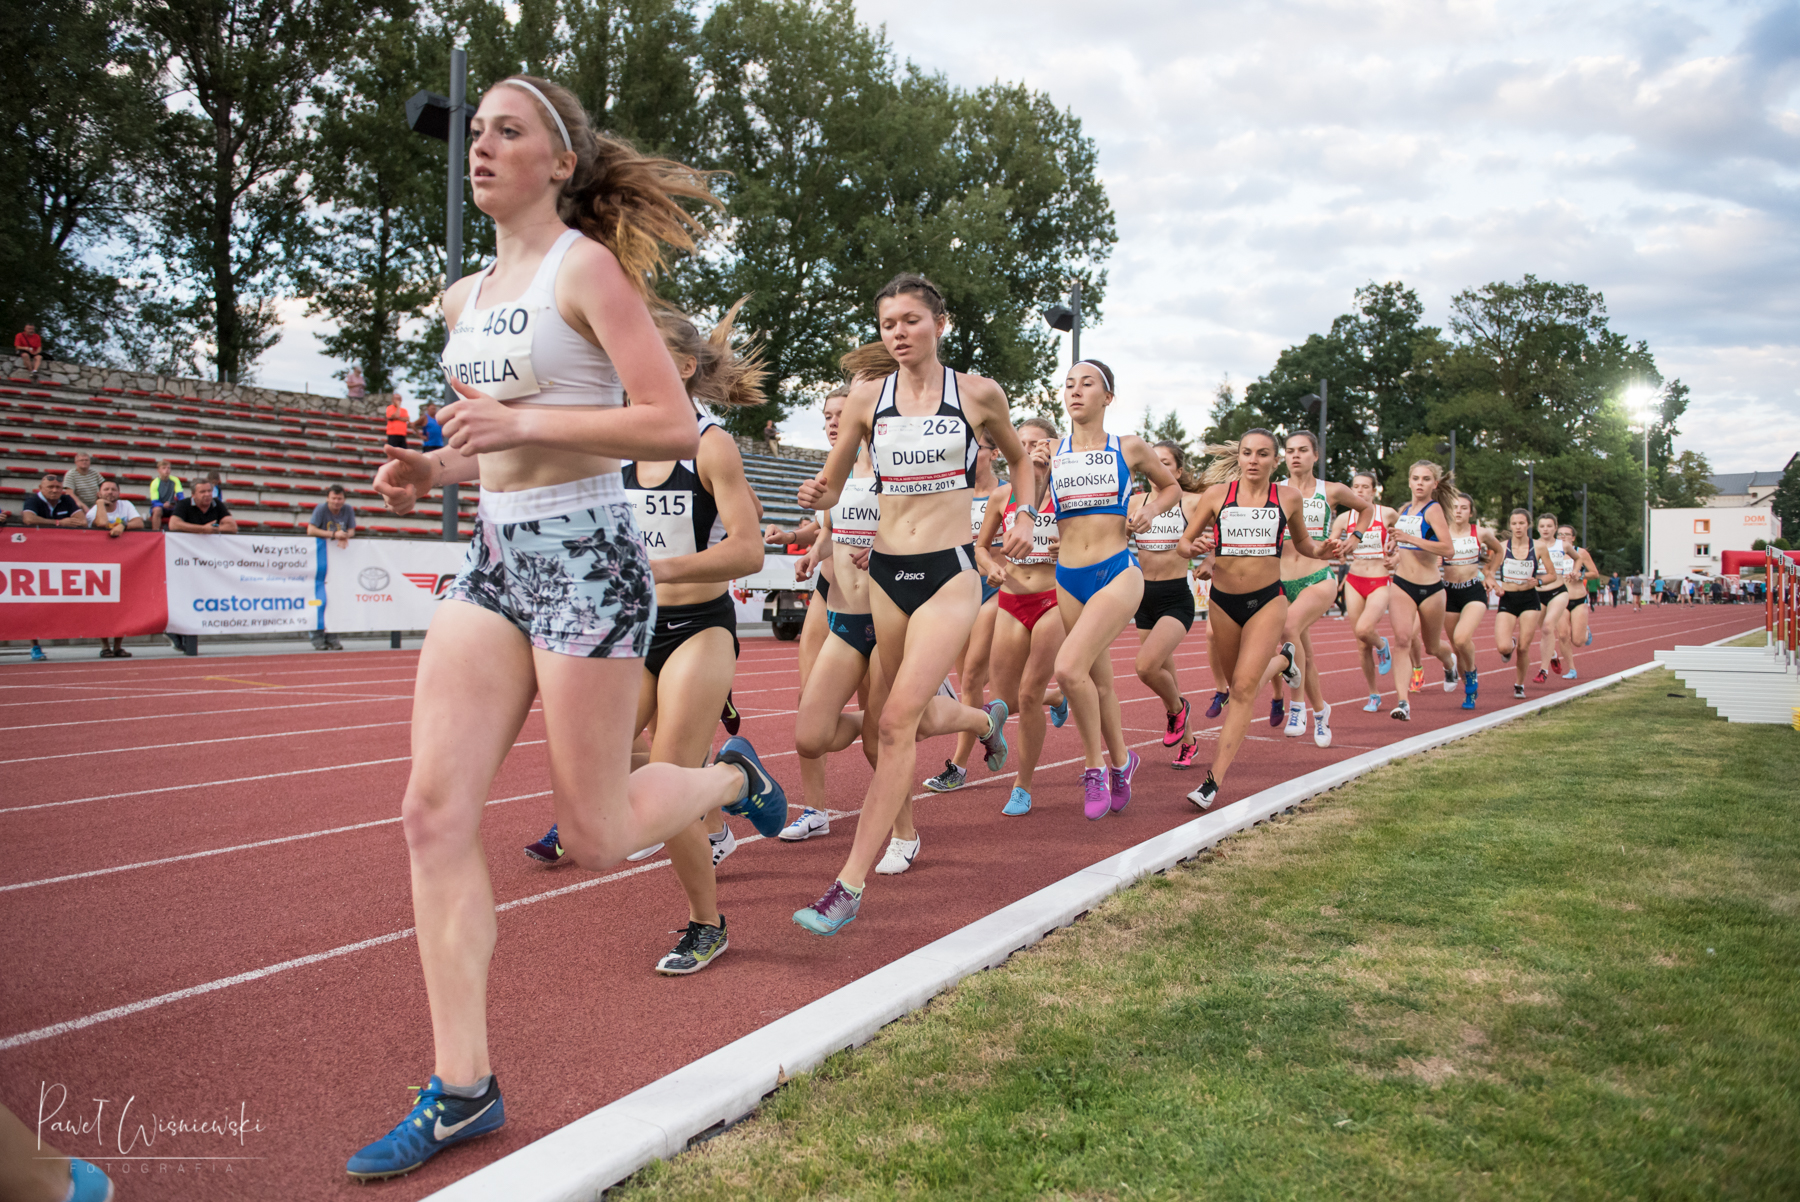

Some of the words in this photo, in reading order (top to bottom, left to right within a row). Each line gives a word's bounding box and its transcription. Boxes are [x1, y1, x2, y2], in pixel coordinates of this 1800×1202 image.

[482, 308, 529, 336] 460
[922, 419, 961, 436] 262
[892, 448, 947, 466] DUDEK
[1085, 452, 1114, 466] 380
[889, 481, 933, 493] RACIBÓRZ
[935, 479, 956, 490] 2019
[1055, 473, 1116, 490] JABŁOŃSKA
[645, 494, 686, 516] 515
[1061, 499, 1092, 510] RACIBÓRZ
[1093, 498, 1110, 506] 2019
[1303, 499, 1323, 509] 540
[1251, 509, 1276, 520] 370
[1227, 528, 1271, 537] MATYSIK
[252, 544, 308, 556] Wszystko
[174, 557, 190, 566] dla
[192, 557, 235, 569] Twojego
[237, 559, 265, 568] domu
[271, 559, 308, 570] ogrodu!
[0, 568, 111, 596] RLEN
[903, 572, 925, 580] asics
[1451, 580, 1472, 589] NIKE
[192, 595, 305, 612] castorama
[355, 594, 393, 602] TOYOTA
[250, 617, 295, 627] RYBNICKA
